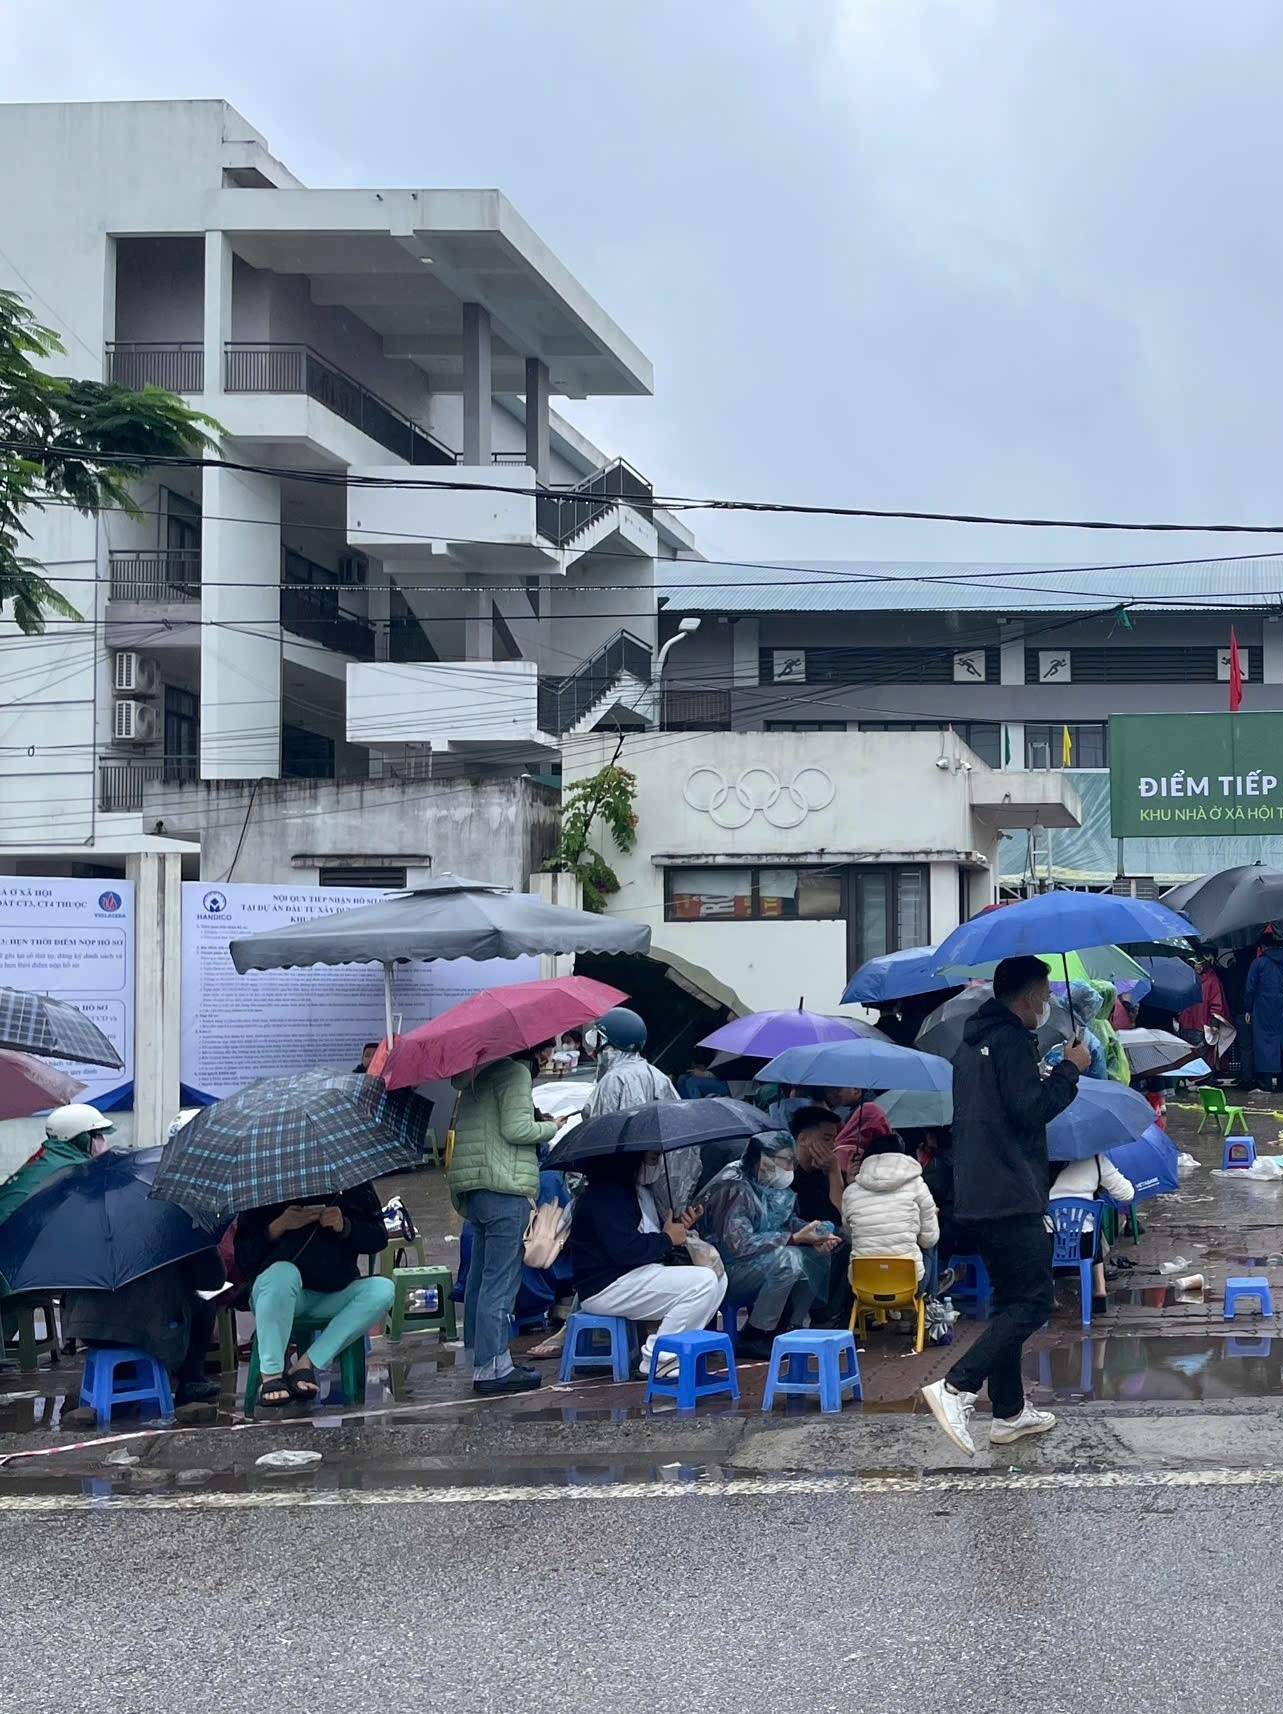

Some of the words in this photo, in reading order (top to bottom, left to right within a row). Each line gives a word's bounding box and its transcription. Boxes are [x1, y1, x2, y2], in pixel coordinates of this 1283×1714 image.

[1138, 769, 1209, 797] ĐIỂM
[1218, 769, 1278, 796] TIẾP
[1140, 808, 1171, 821] KHU
[1175, 805, 1207, 821] NHÀ
[1209, 805, 1222, 820] Ở
[1225, 805, 1245, 820] XÃ
[1247, 804, 1274, 822] HỘI
[35, 889, 52, 898] HỘI
[16, 900, 35, 908] CT3,
[56, 900, 88, 910] THUỘC
[272, 894, 288, 903] NỘI
[289, 895, 307, 904] QUY
[309, 894, 327, 903] TIẾP
[328, 895, 350, 905] NHẬN
[353, 896, 365, 904] HỒ
[241, 904, 257, 913] TẠI
[257, 903, 269, 913] DỰ
[272, 903, 283, 912] ÁN
[285, 904, 303, 913] ĐẦU
[318, 905, 335, 914] XÂY
